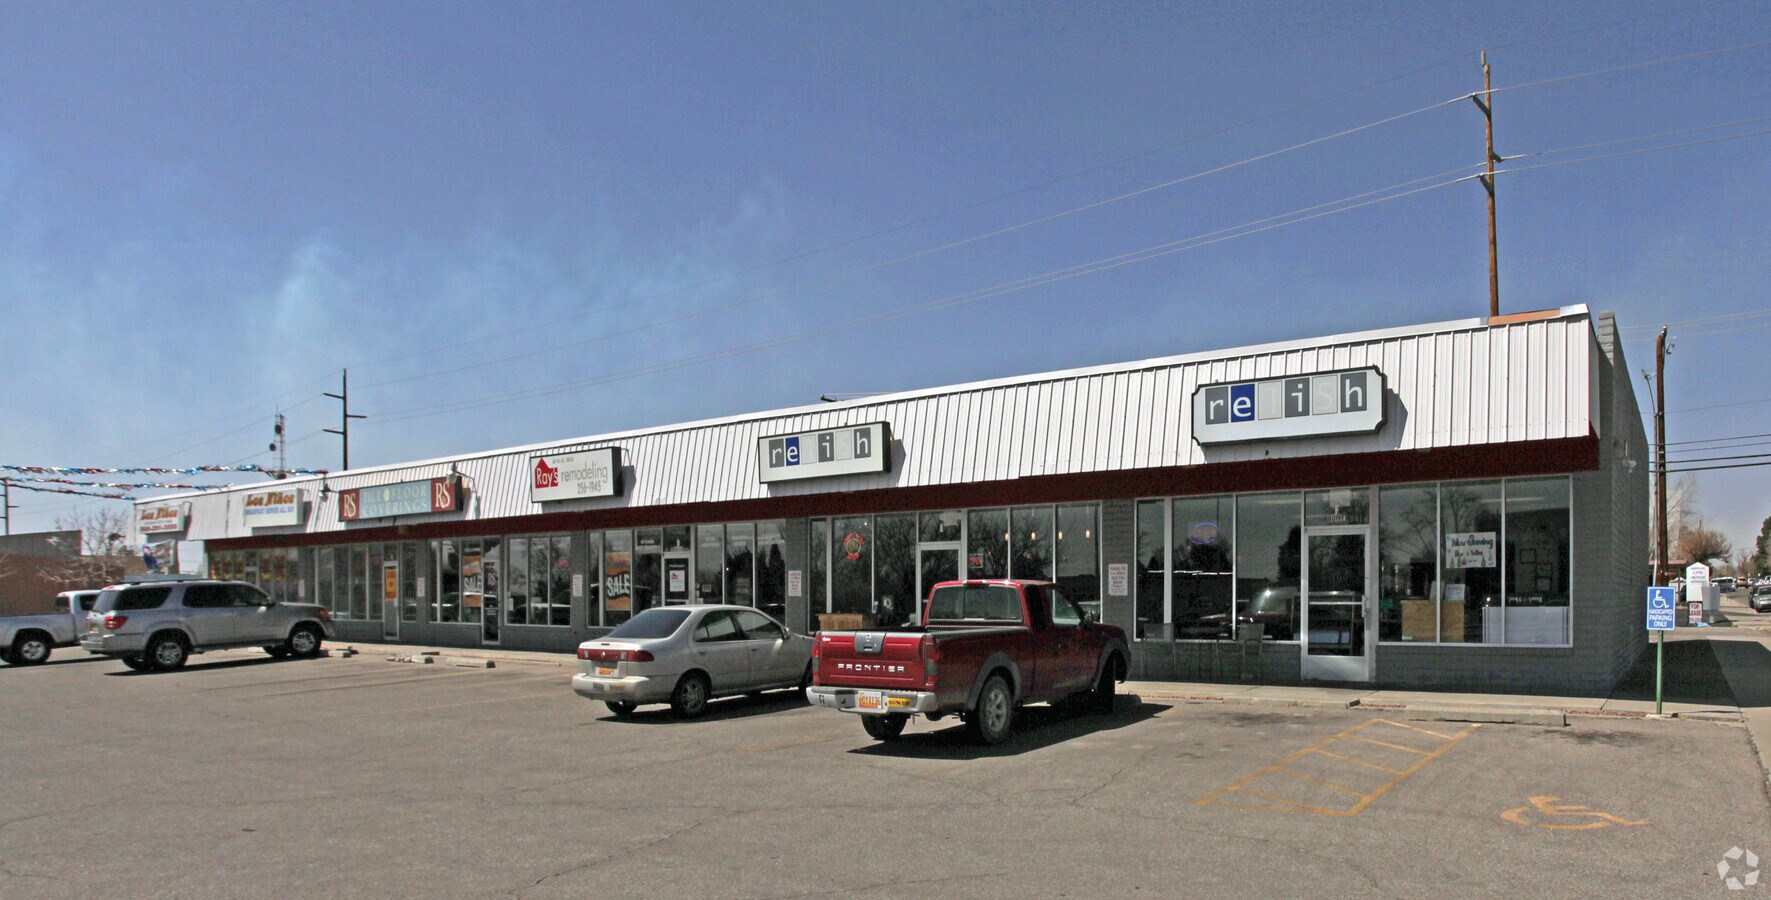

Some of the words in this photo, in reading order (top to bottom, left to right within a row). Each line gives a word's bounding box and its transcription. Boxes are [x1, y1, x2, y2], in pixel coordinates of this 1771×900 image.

[1208, 378, 1364, 421] relish
[771, 431, 869, 465] relish
[536, 467, 558, 488] Ray's
[560, 461, 608, 484] remodeling
[391, 485, 427, 500] FLOOR
[362, 499, 427, 517] COVERINGS
[463, 575, 481, 592] SALE
[606, 573, 630, 598] SALE
[837, 663, 905, 673] FRONTIER
